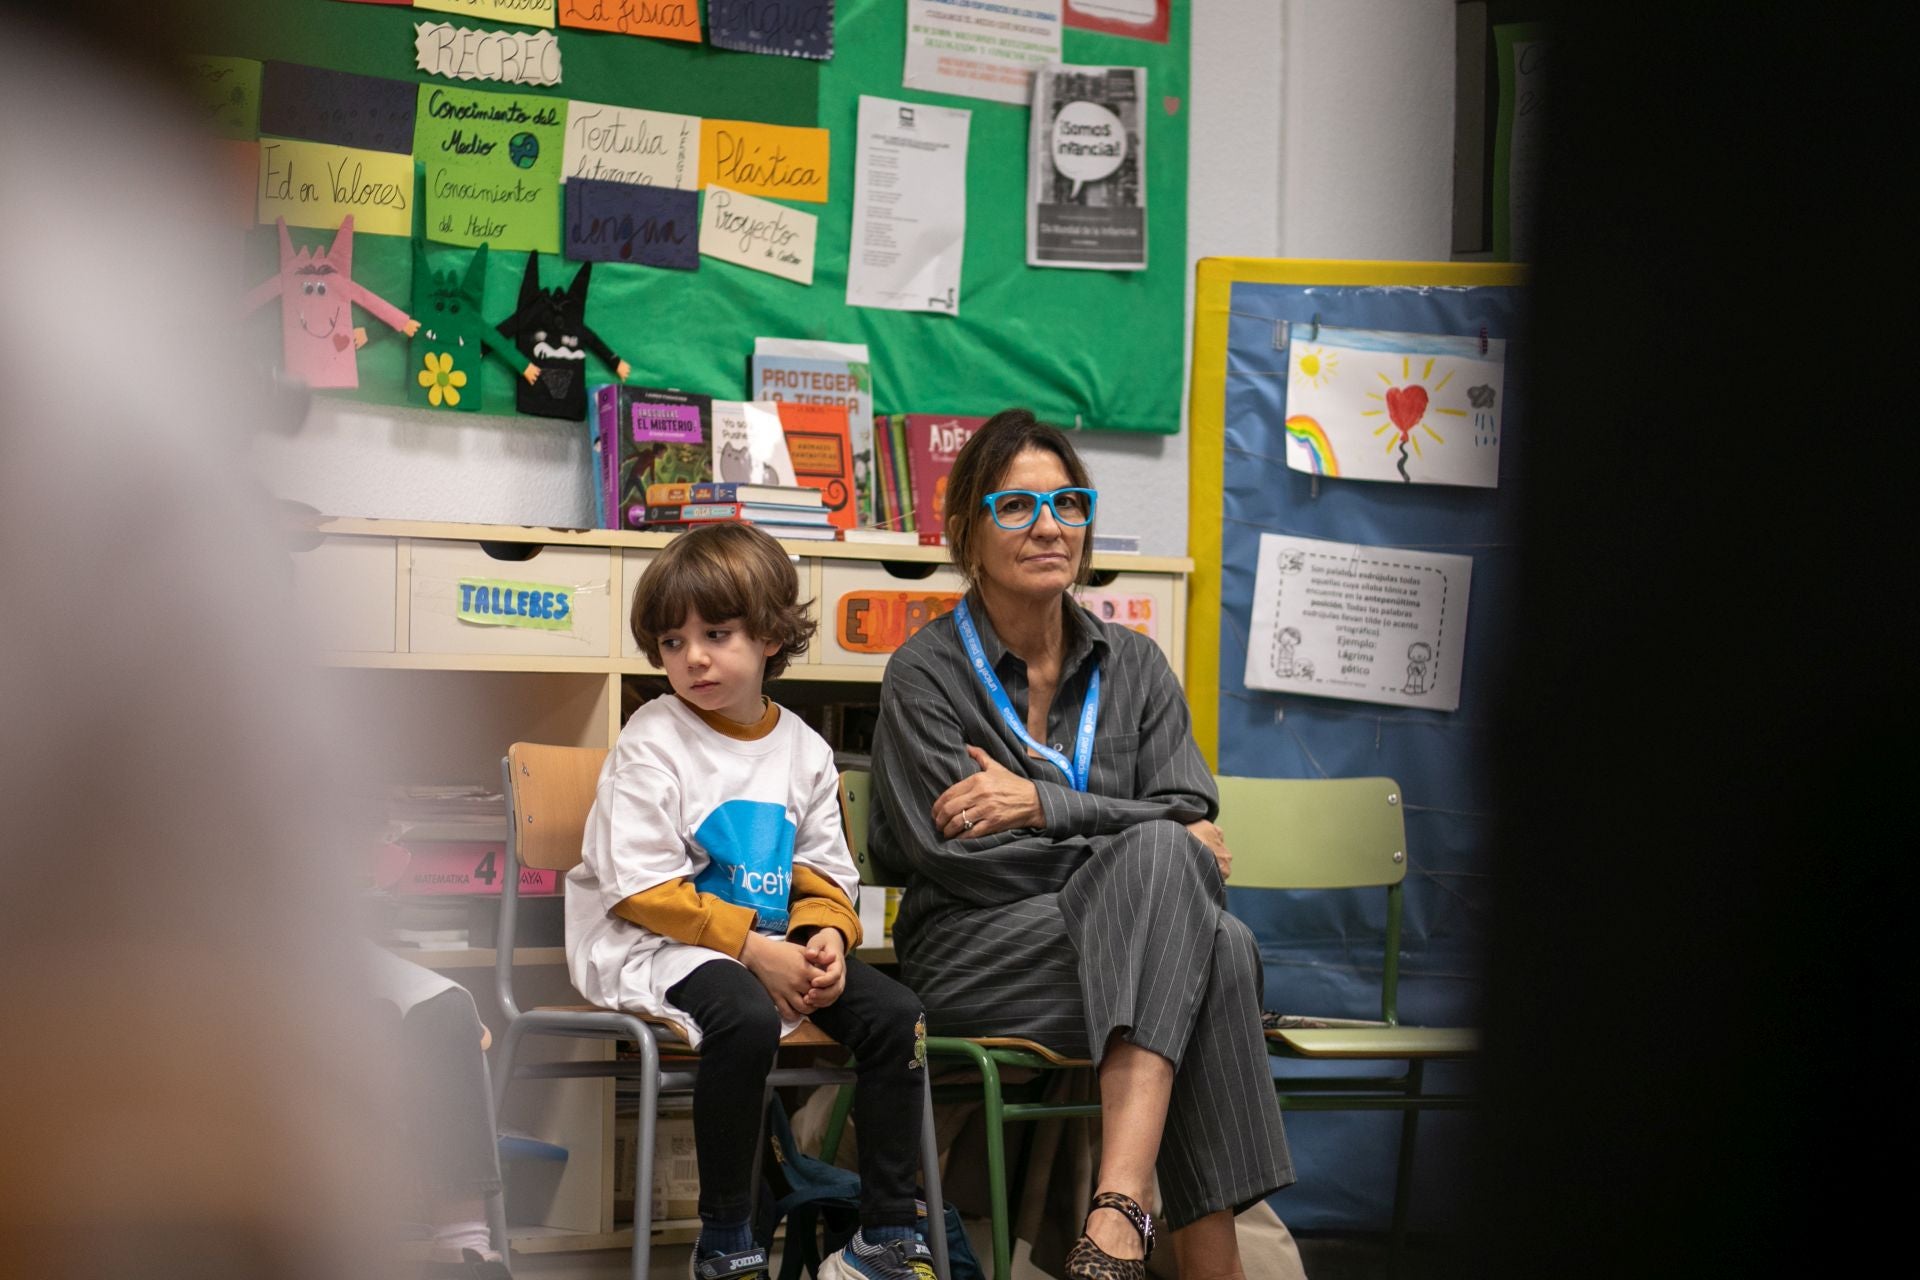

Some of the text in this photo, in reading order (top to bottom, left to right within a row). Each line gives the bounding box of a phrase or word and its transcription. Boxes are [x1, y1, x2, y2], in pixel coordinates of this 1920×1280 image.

[429, 89, 560, 126] Conocimiento del
[441, 129, 497, 156] Medio
[573, 109, 668, 155] Tertulia
[716, 130, 820, 187] Plástica
[265, 144, 294, 201] Ed
[328, 156, 406, 210] Valores
[434, 168, 542, 203] Conocimiento
[439, 214, 507, 237] del Medio
[711, 190, 799, 253] Proyecto
[762, 368, 859, 393] PROTEGER
[794, 392, 859, 415] TIERRA
[637, 419, 648, 430] EL
[1337, 636, 1377, 649] Ejemplo:
[474, 851, 496, 886] 4
